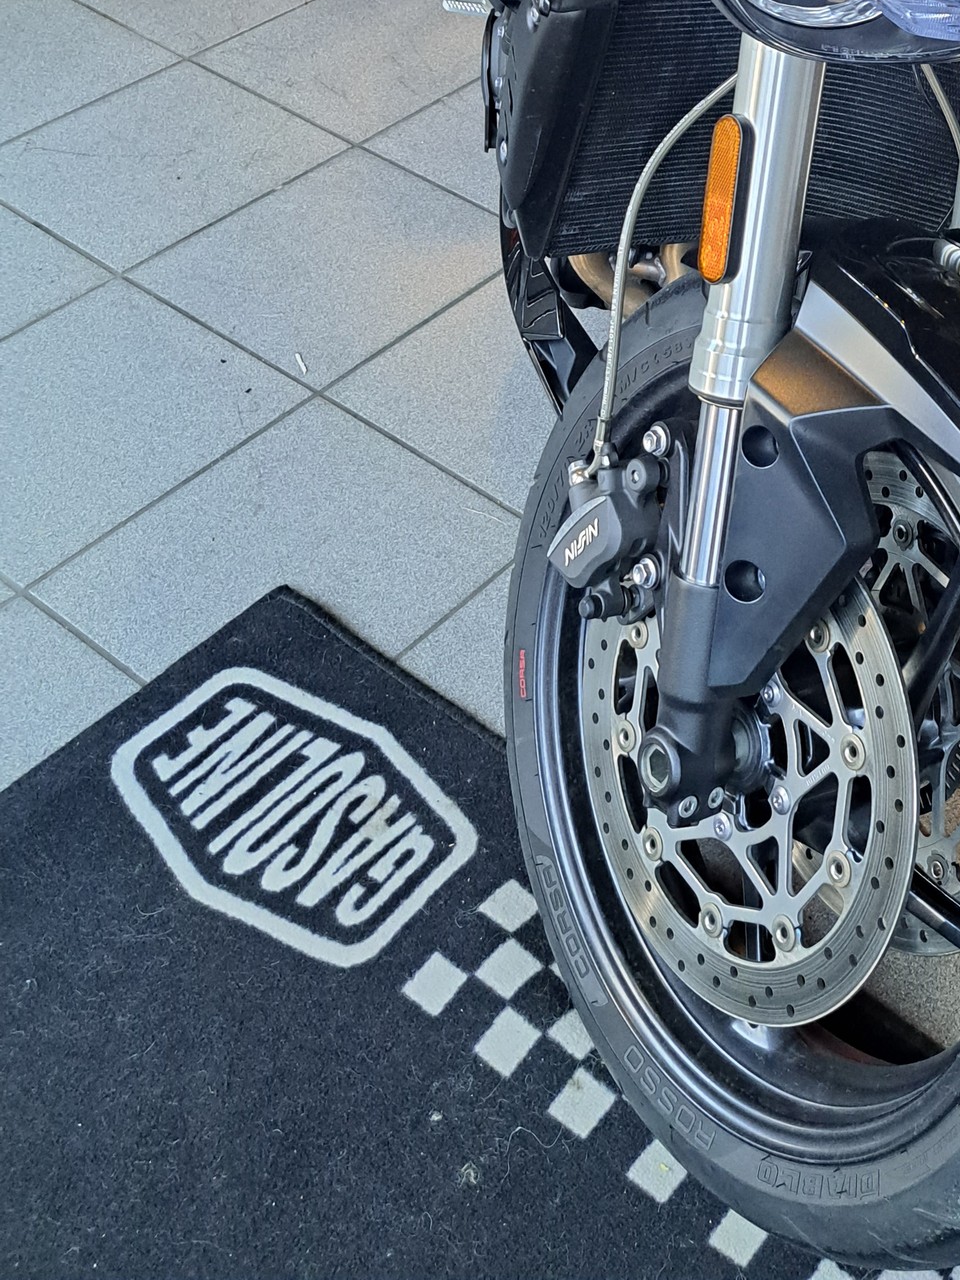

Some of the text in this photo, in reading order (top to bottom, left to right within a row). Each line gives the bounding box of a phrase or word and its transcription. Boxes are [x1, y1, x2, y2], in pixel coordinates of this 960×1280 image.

[564, 517, 599, 567] NISSIN
[519, 649, 527, 698] CORSA
[152, 697, 435, 927] GASOLINE
[541, 865, 589, 979] CORSA
[623, 1045, 716, 1151] ROSSO
[757, 1159, 881, 1201] DIABLO
